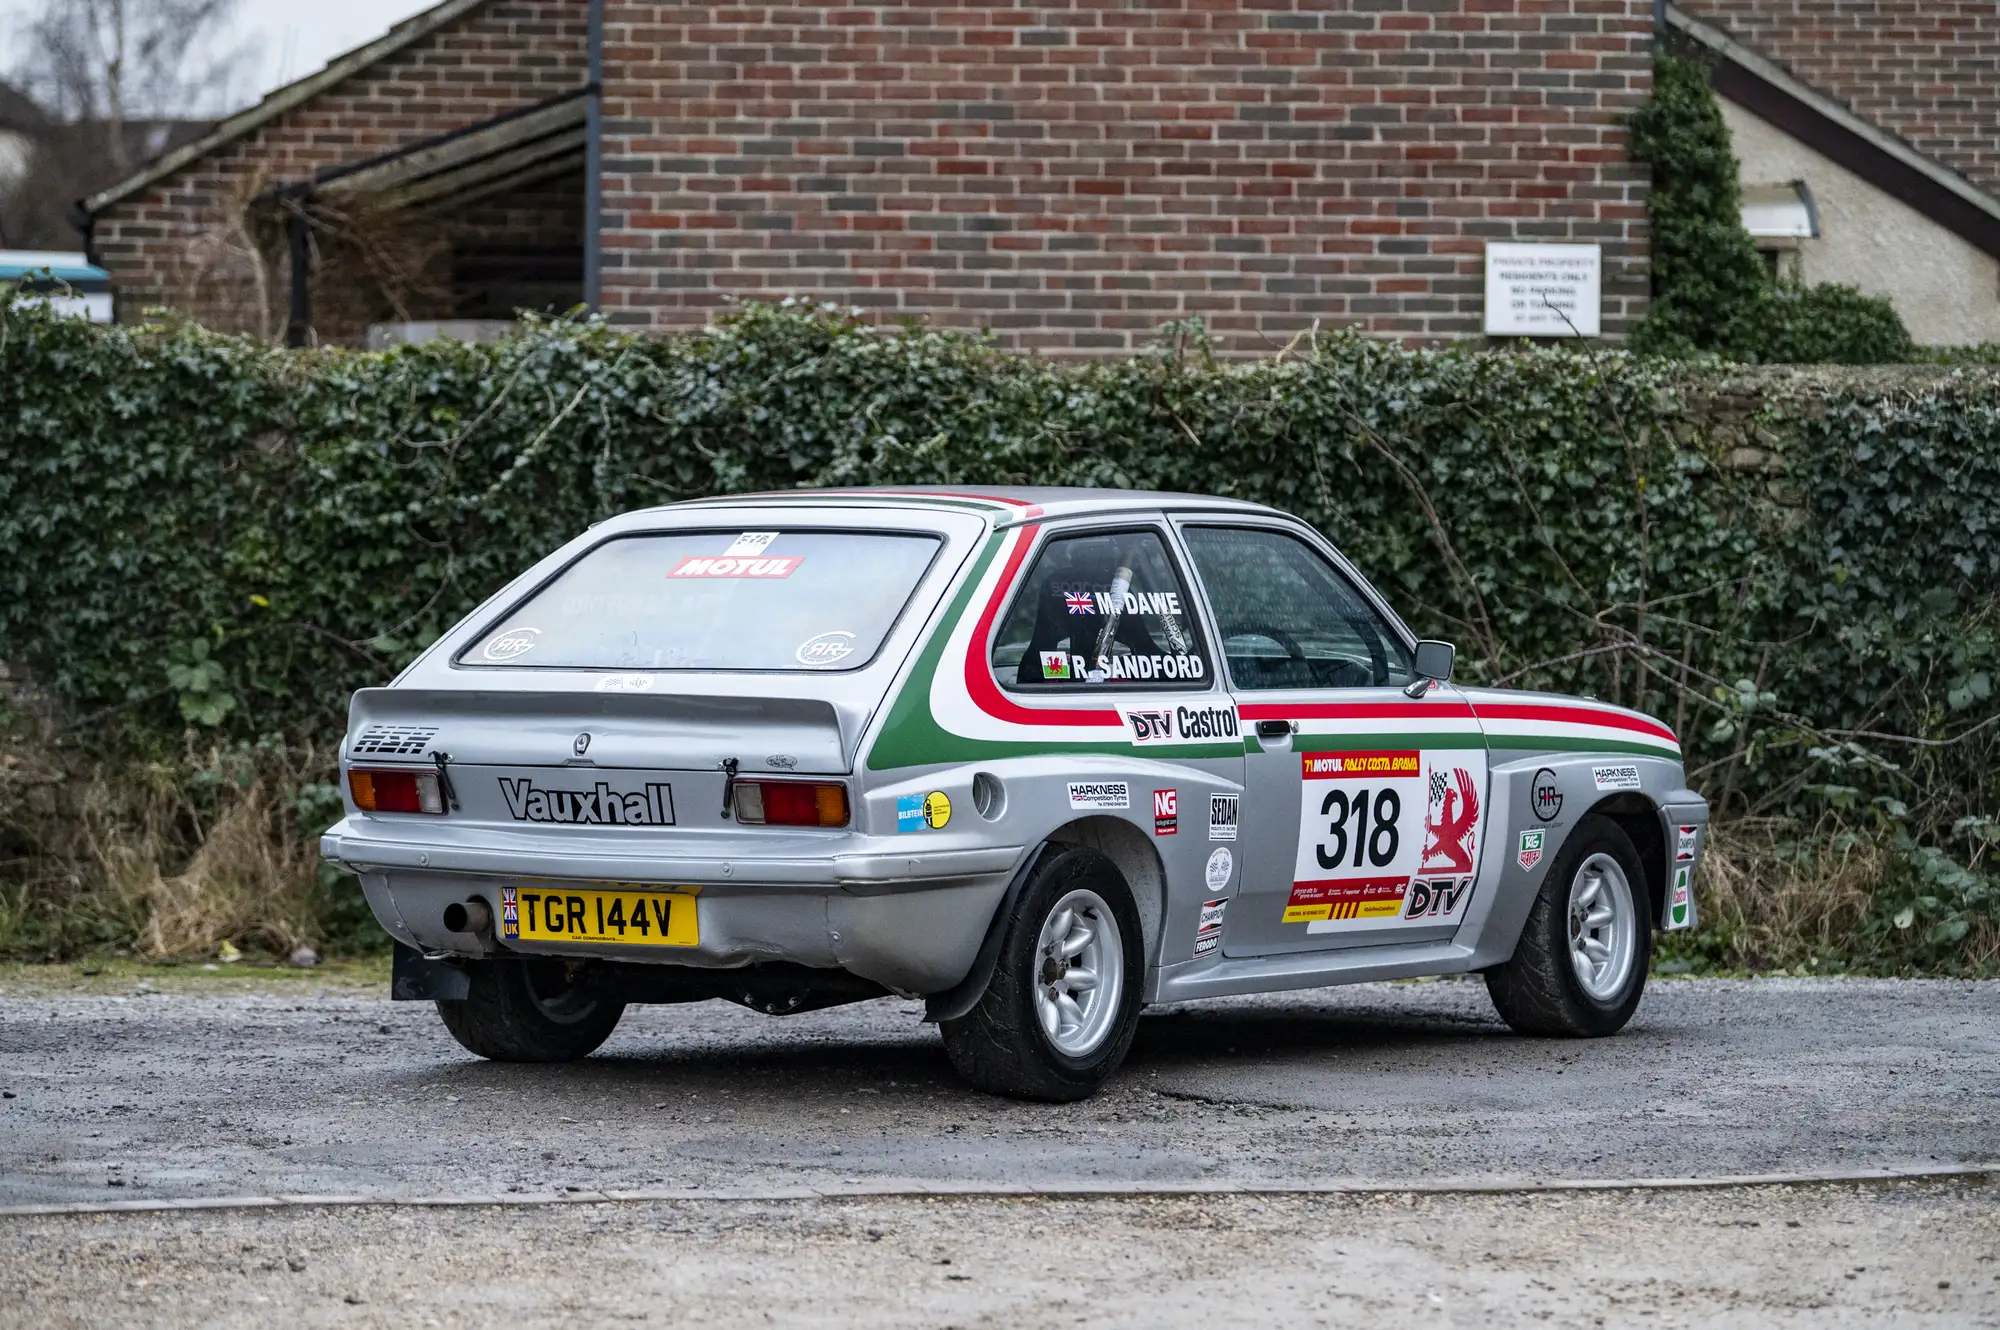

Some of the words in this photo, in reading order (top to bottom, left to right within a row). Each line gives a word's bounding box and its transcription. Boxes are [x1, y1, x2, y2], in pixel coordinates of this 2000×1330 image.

[673, 558, 793, 576] MOTUL
[1095, 592, 1121, 615] M.
[1124, 592, 1182, 615] DAWE
[1071, 655, 1093, 678] R.
[1097, 655, 1205, 679] SANDFORD
[1127, 711, 1173, 741] DTV
[1177, 706, 1238, 738] Castrol
[1314, 759, 1343, 772] MOTUL
[1343, 758, 1368, 771] RALLY
[1367, 757, 1391, 771] COSTA
[1391, 757, 1418, 771] BRAVA
[1595, 767, 1637, 778] HARKNESS
[1070, 784, 1127, 795] HARKNESS
[498, 777, 677, 827] Vauxhall
[1154, 791, 1177, 816] NG
[898, 808, 924, 820] BILSTEIN
[1211, 798, 1238, 826] SEDAN
[1316, 788, 1401, 870] 318
[1524, 835, 1540, 849] TAG
[1521, 851, 1540, 867] HEUER
[1404, 876, 1474, 920] DTV
[521, 894, 587, 934] TGR
[596, 896, 672, 937] 144V
[1201, 907, 1225, 923] CHAMPION
[504, 922, 518, 935] UK
[1196, 938, 1218, 952] FERODO
